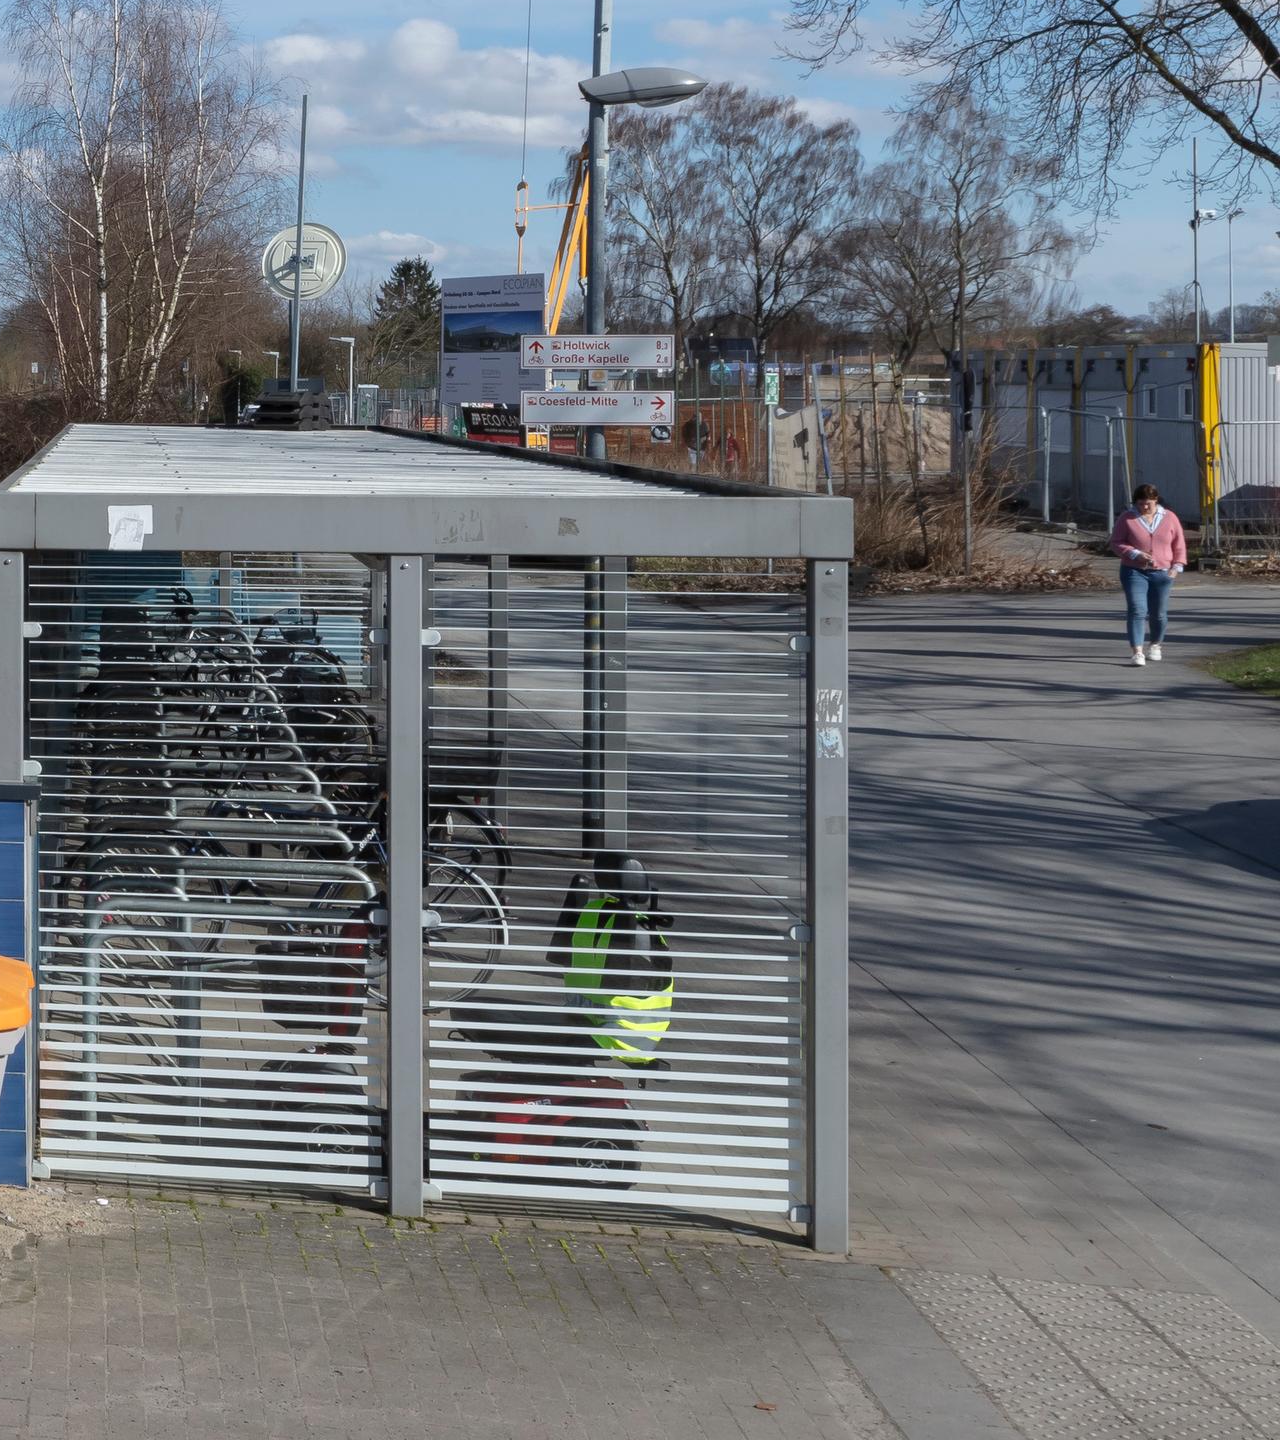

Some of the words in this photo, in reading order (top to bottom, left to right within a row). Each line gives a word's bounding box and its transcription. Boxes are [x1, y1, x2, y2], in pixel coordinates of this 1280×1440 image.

[563, 341, 610, 350] Holtwick
[551, 354, 585, 364] Große
[588, 354, 630, 366] Kapelle
[538, 396, 618, 406] Coesfeld-Mitte
